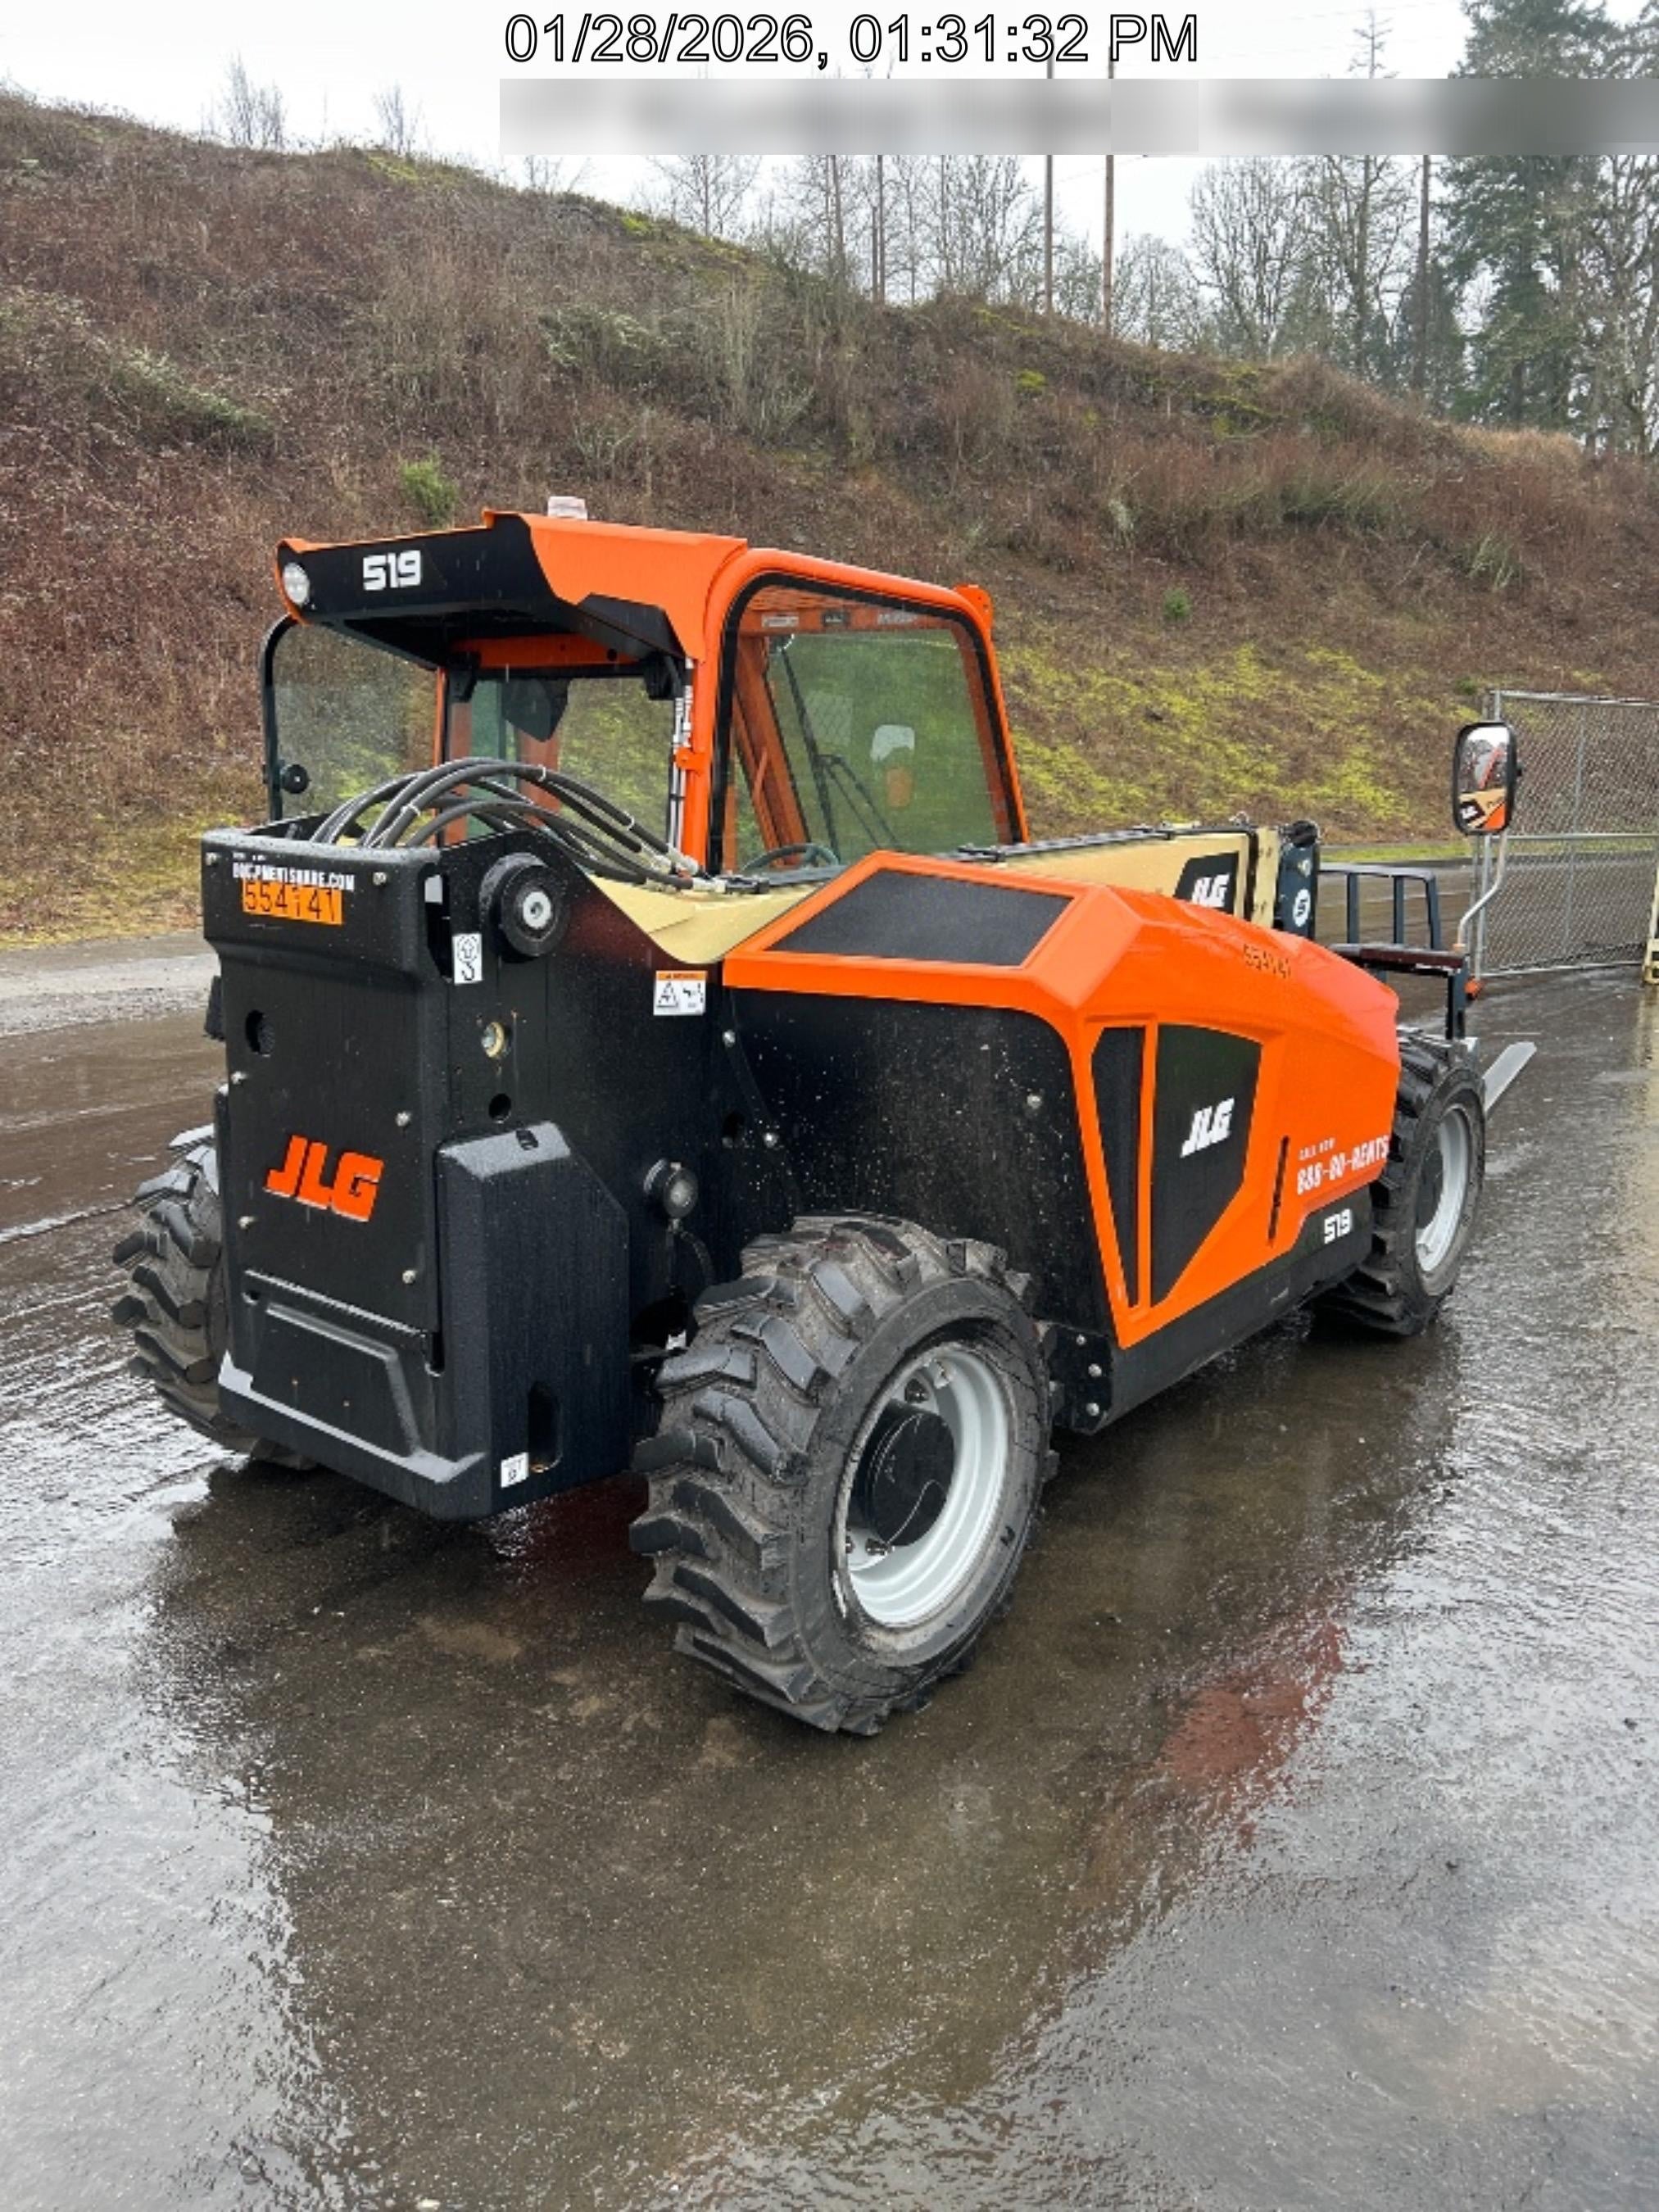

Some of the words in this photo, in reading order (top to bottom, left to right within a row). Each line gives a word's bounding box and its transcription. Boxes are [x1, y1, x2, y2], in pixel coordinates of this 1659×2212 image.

[363, 551, 422, 590] 519
[245, 881, 335, 922] 554141
[1180, 1098, 1235, 1158] JLG
[264, 1135, 384, 1222] JLG
[1324, 1208, 1352, 1244] 519
